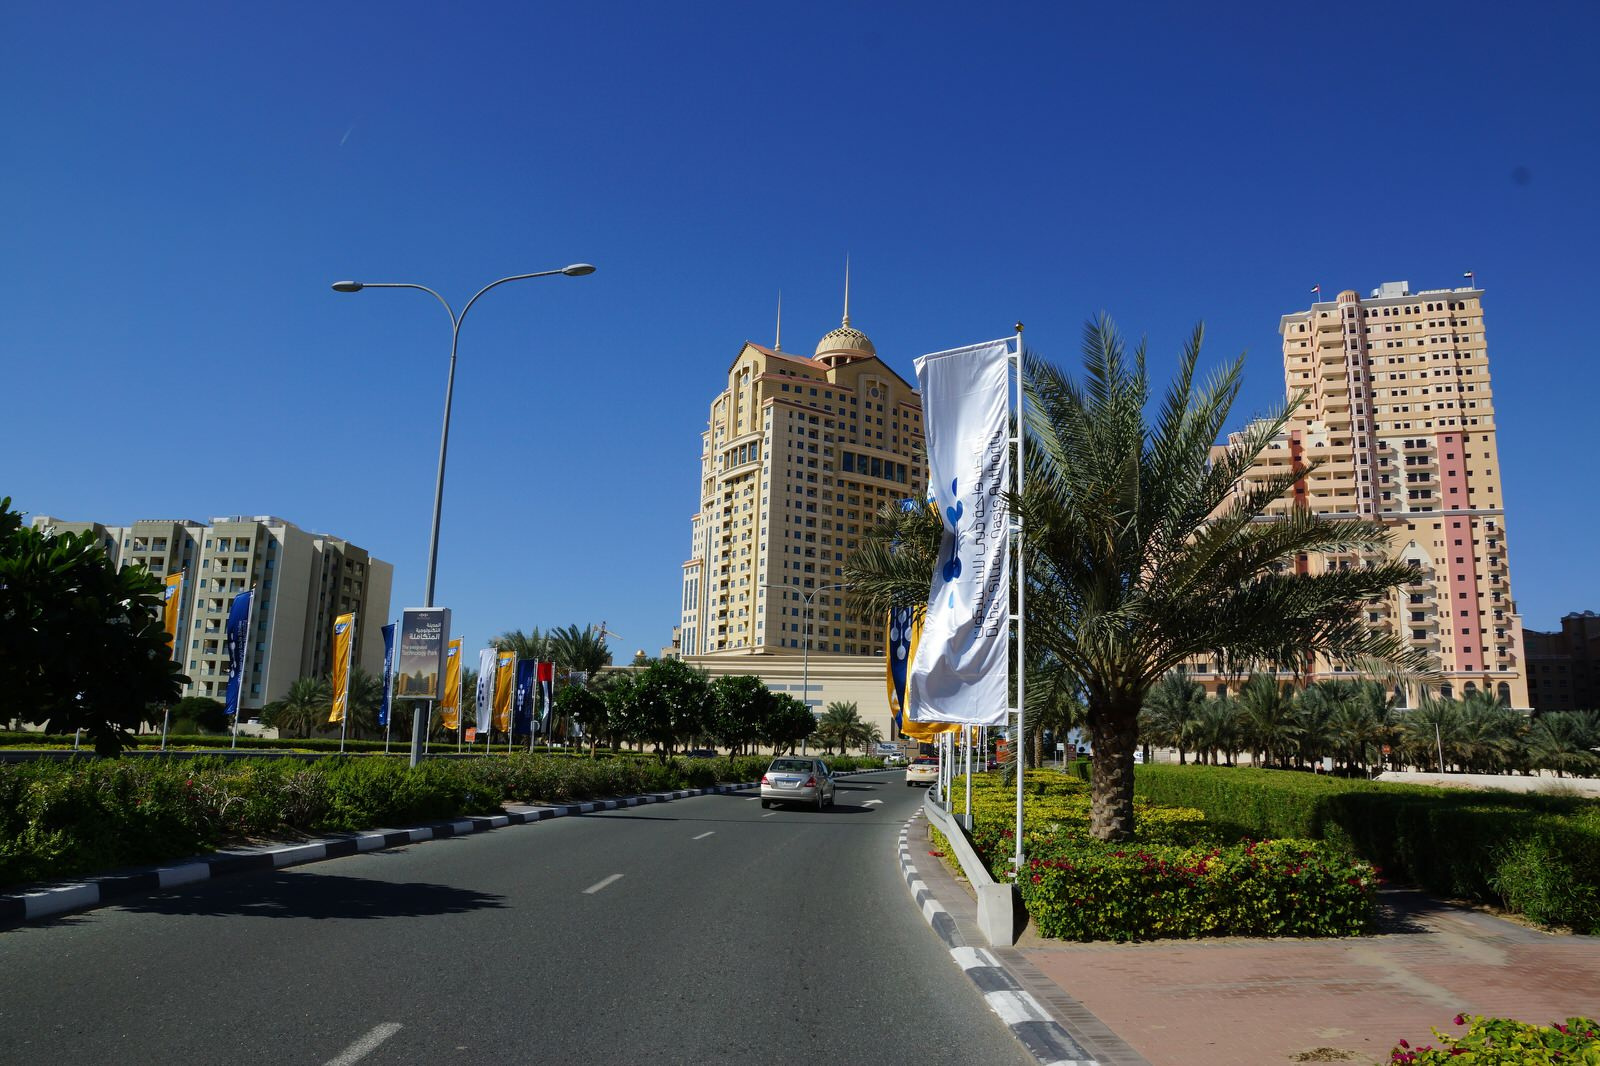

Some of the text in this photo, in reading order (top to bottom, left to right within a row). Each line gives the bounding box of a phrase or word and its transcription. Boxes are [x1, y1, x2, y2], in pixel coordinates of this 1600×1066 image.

[972, 483, 984, 518] واحة
[975, 522, 988, 556] دبي
[985, 430, 1003, 638] Dubai Silicon Oasis Authority
